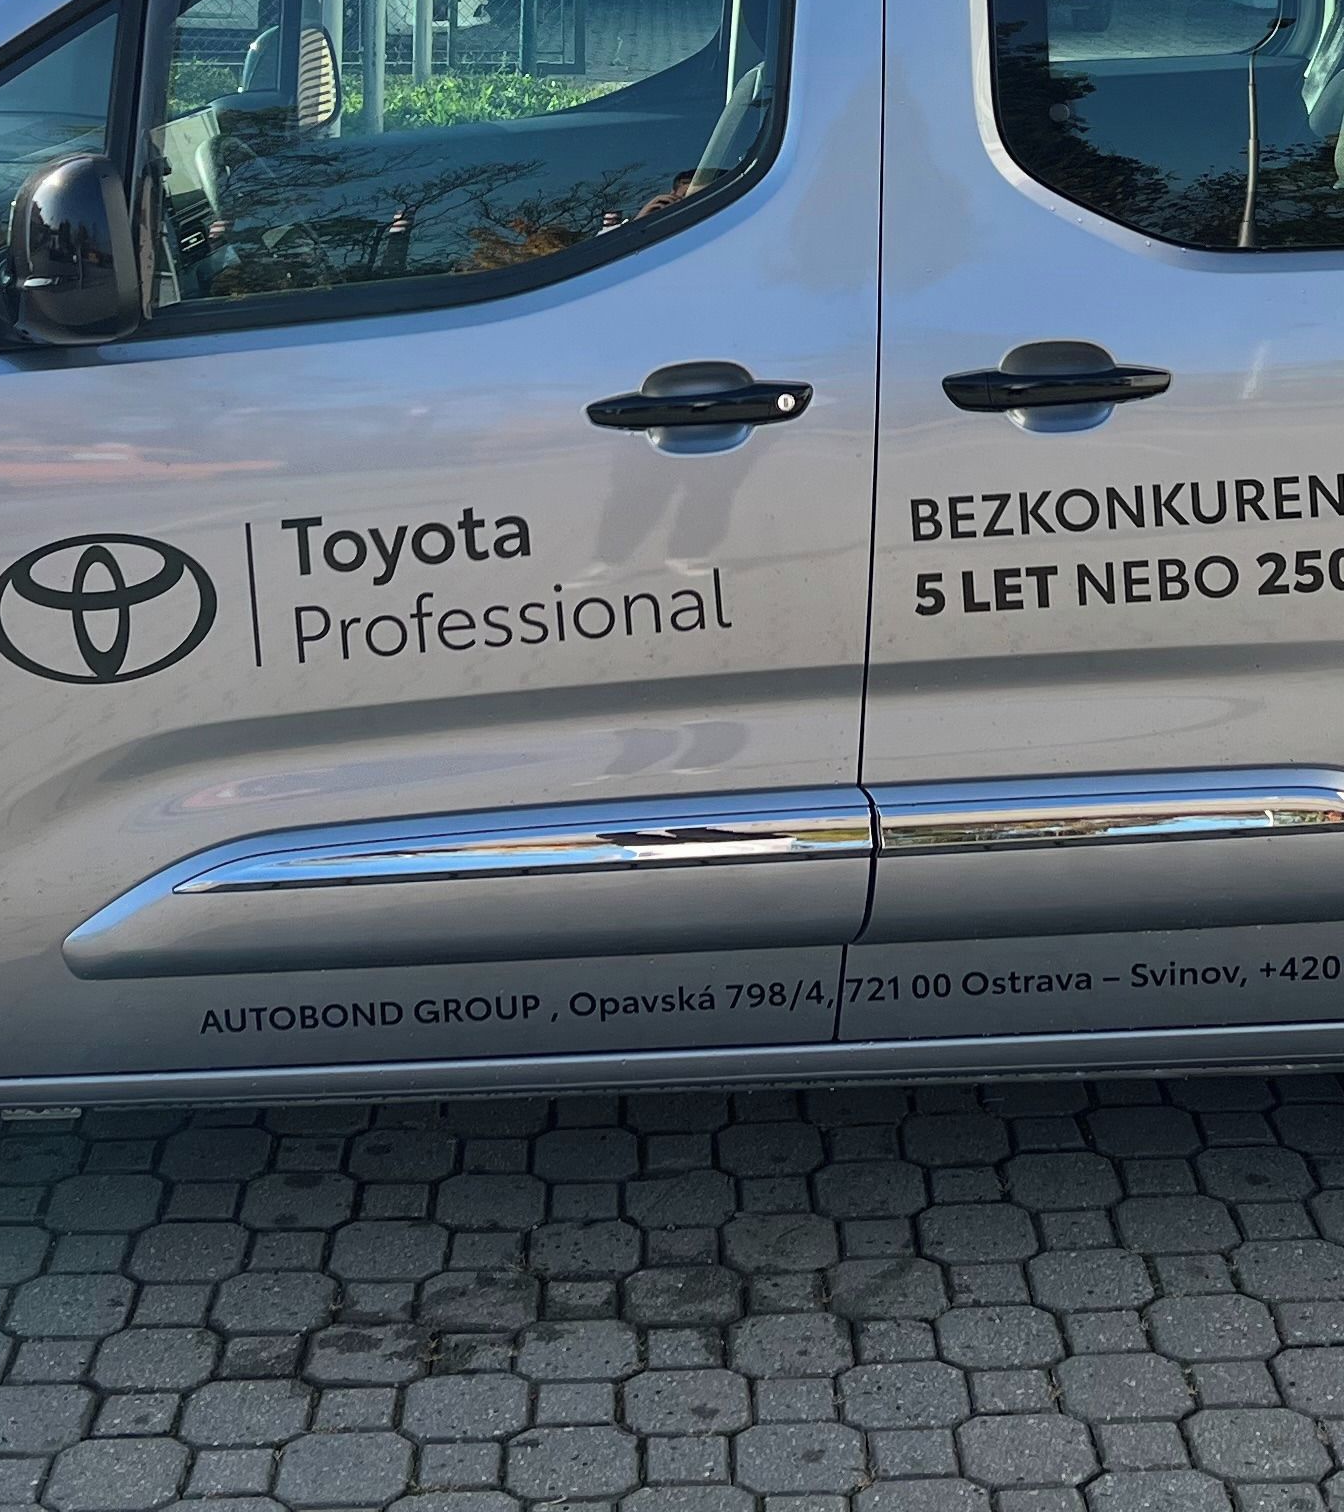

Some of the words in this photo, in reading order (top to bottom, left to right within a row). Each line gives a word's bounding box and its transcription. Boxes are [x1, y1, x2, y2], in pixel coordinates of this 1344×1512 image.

[281, 507, 532, 587] Toyota
[914, 571, 946, 616] 5
[960, 565, 1058, 613] LET
[1077, 554, 1240, 606] NEBO
[294, 568, 733, 664] Professional
[199, 1000, 404, 1035] AUTOBOND
[413, 994, 540, 1027] GROUP
[568, 986, 717, 1029] Opavská
[725, 979, 835, 1012] 798/4,
[845, 975, 901, 1003] 721
[911, 973, 952, 1000] 00
[962, 967, 1093, 997] Ostrava
[1130, 960, 1248, 989] Svinov,
[1259, 954, 1341, 983] +420
